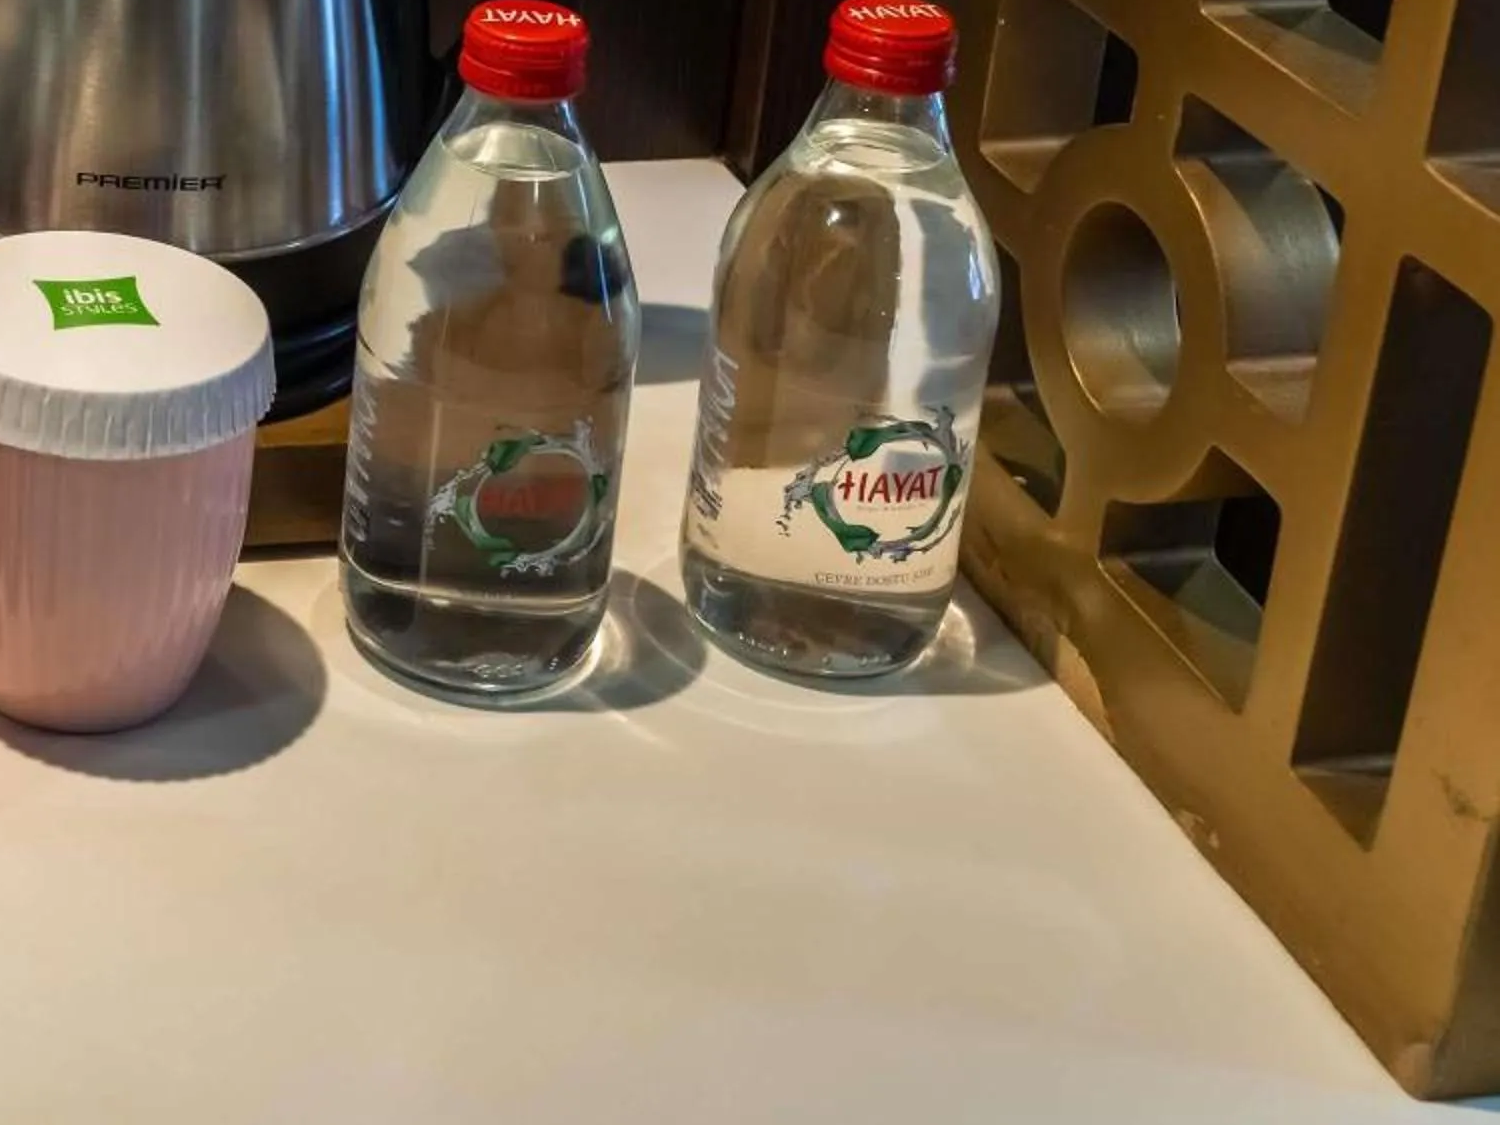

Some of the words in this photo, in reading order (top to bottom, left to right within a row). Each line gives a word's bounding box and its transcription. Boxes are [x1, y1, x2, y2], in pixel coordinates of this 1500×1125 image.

[480, 8, 581, 27] HAYAT
[848, 4, 943, 20] HAYAT
[63, 288, 123, 305] ibis
[837, 465, 945, 503] HAYAT
